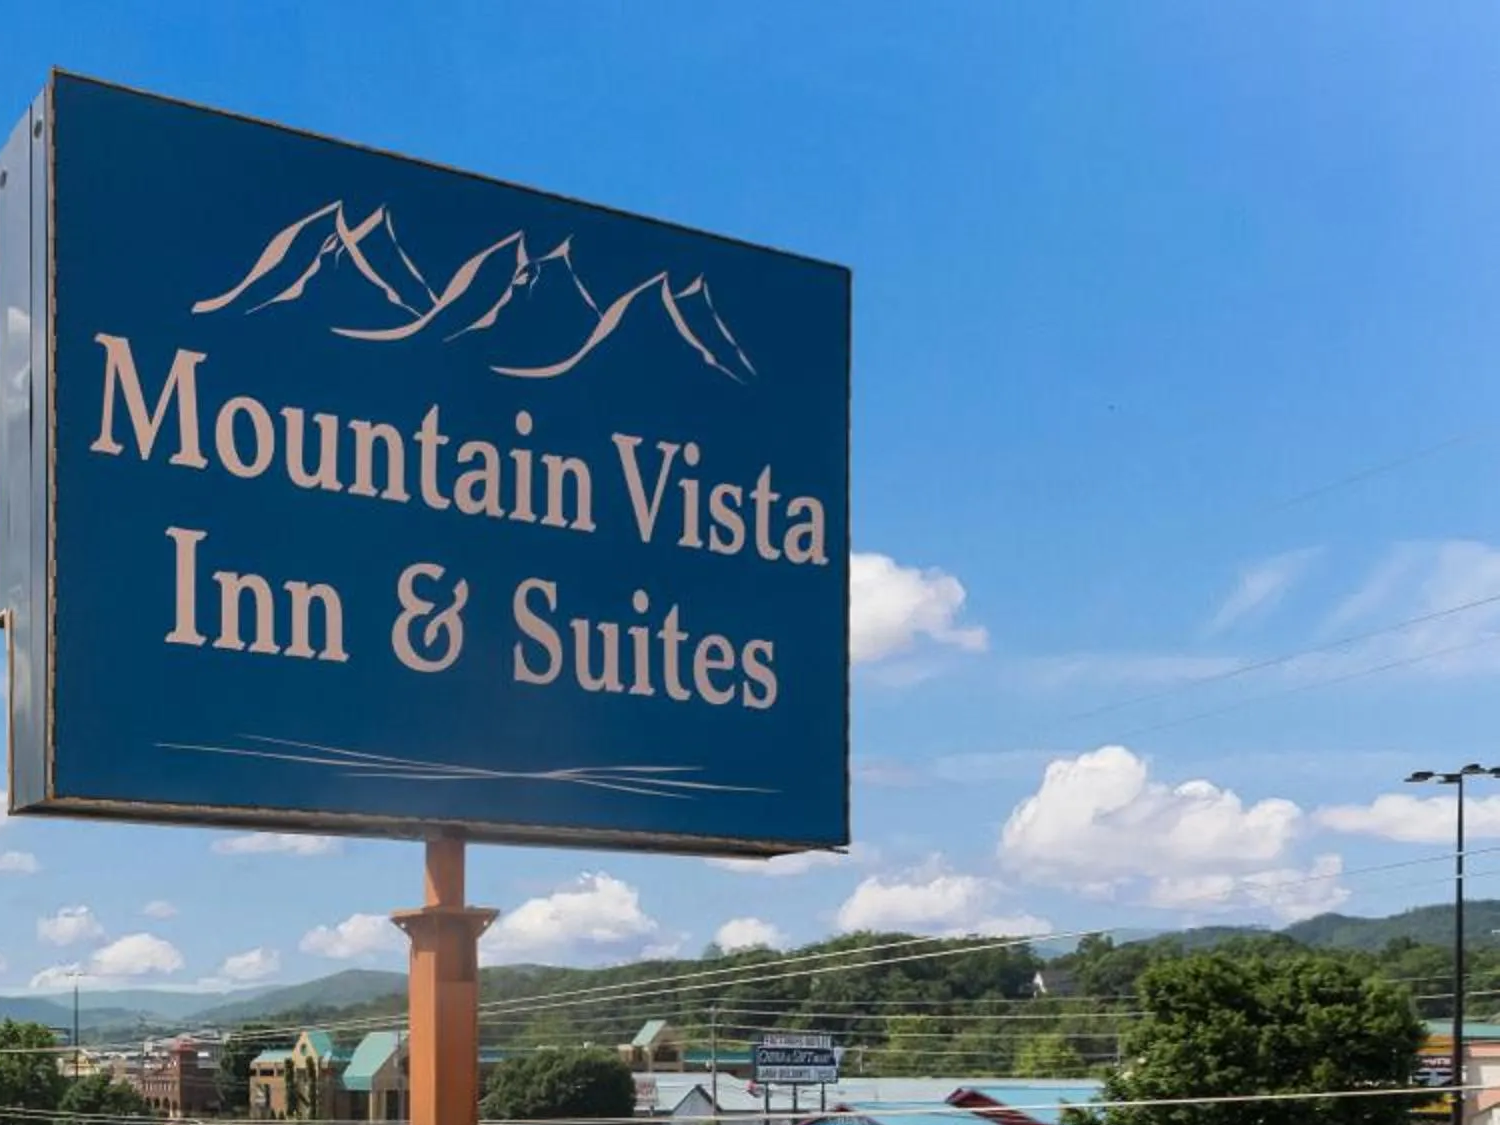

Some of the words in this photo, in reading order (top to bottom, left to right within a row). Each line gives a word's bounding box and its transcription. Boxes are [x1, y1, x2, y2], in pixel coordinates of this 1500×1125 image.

[90, 333, 596, 532] Mountain
[611, 432, 829, 566] Vista
[164, 527, 349, 662] Inn
[392, 563, 468, 673] &
[513, 578, 778, 709] Suites
